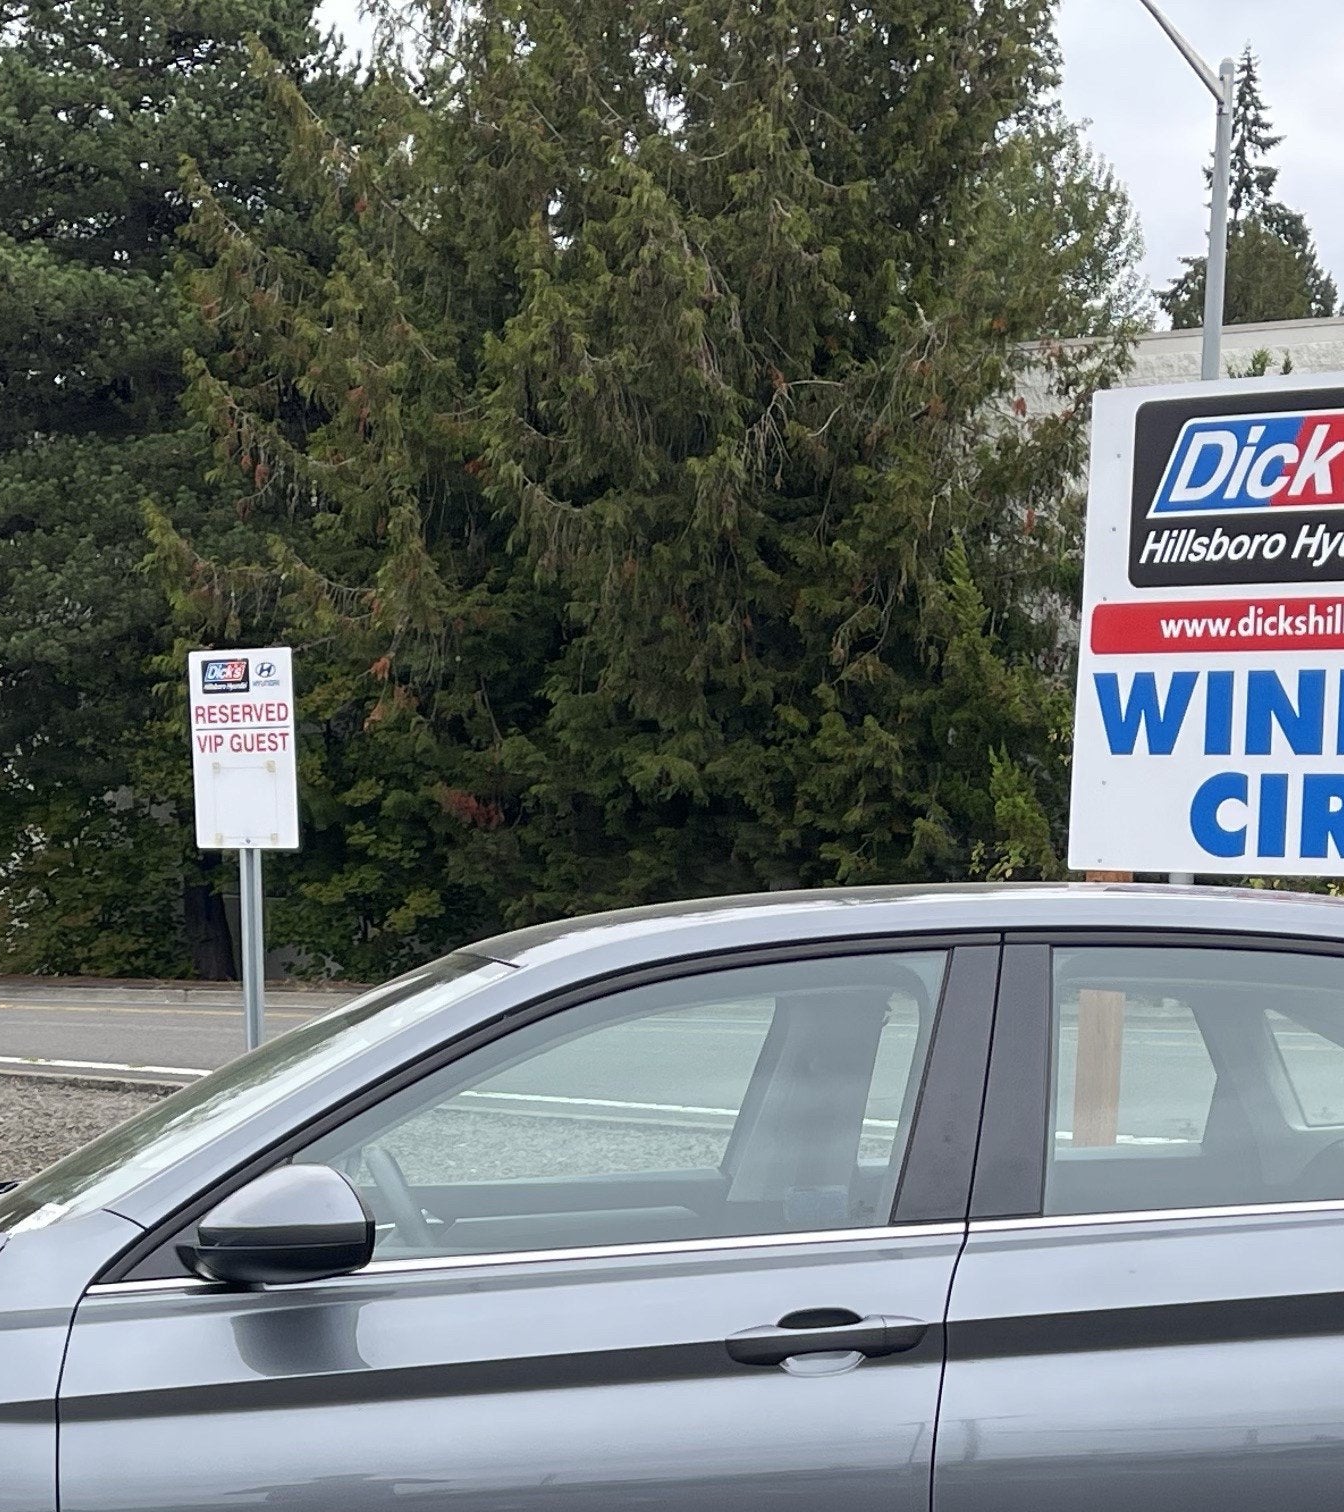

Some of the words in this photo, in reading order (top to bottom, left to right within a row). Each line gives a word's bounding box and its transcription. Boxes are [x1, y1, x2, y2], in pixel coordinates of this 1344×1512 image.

[1138, 527, 1287, 565] Hillsboro
[194, 702, 289, 725] RESERVED
[196, 733, 224, 754] VIP
[229, 731, 290, 752] GUEST
